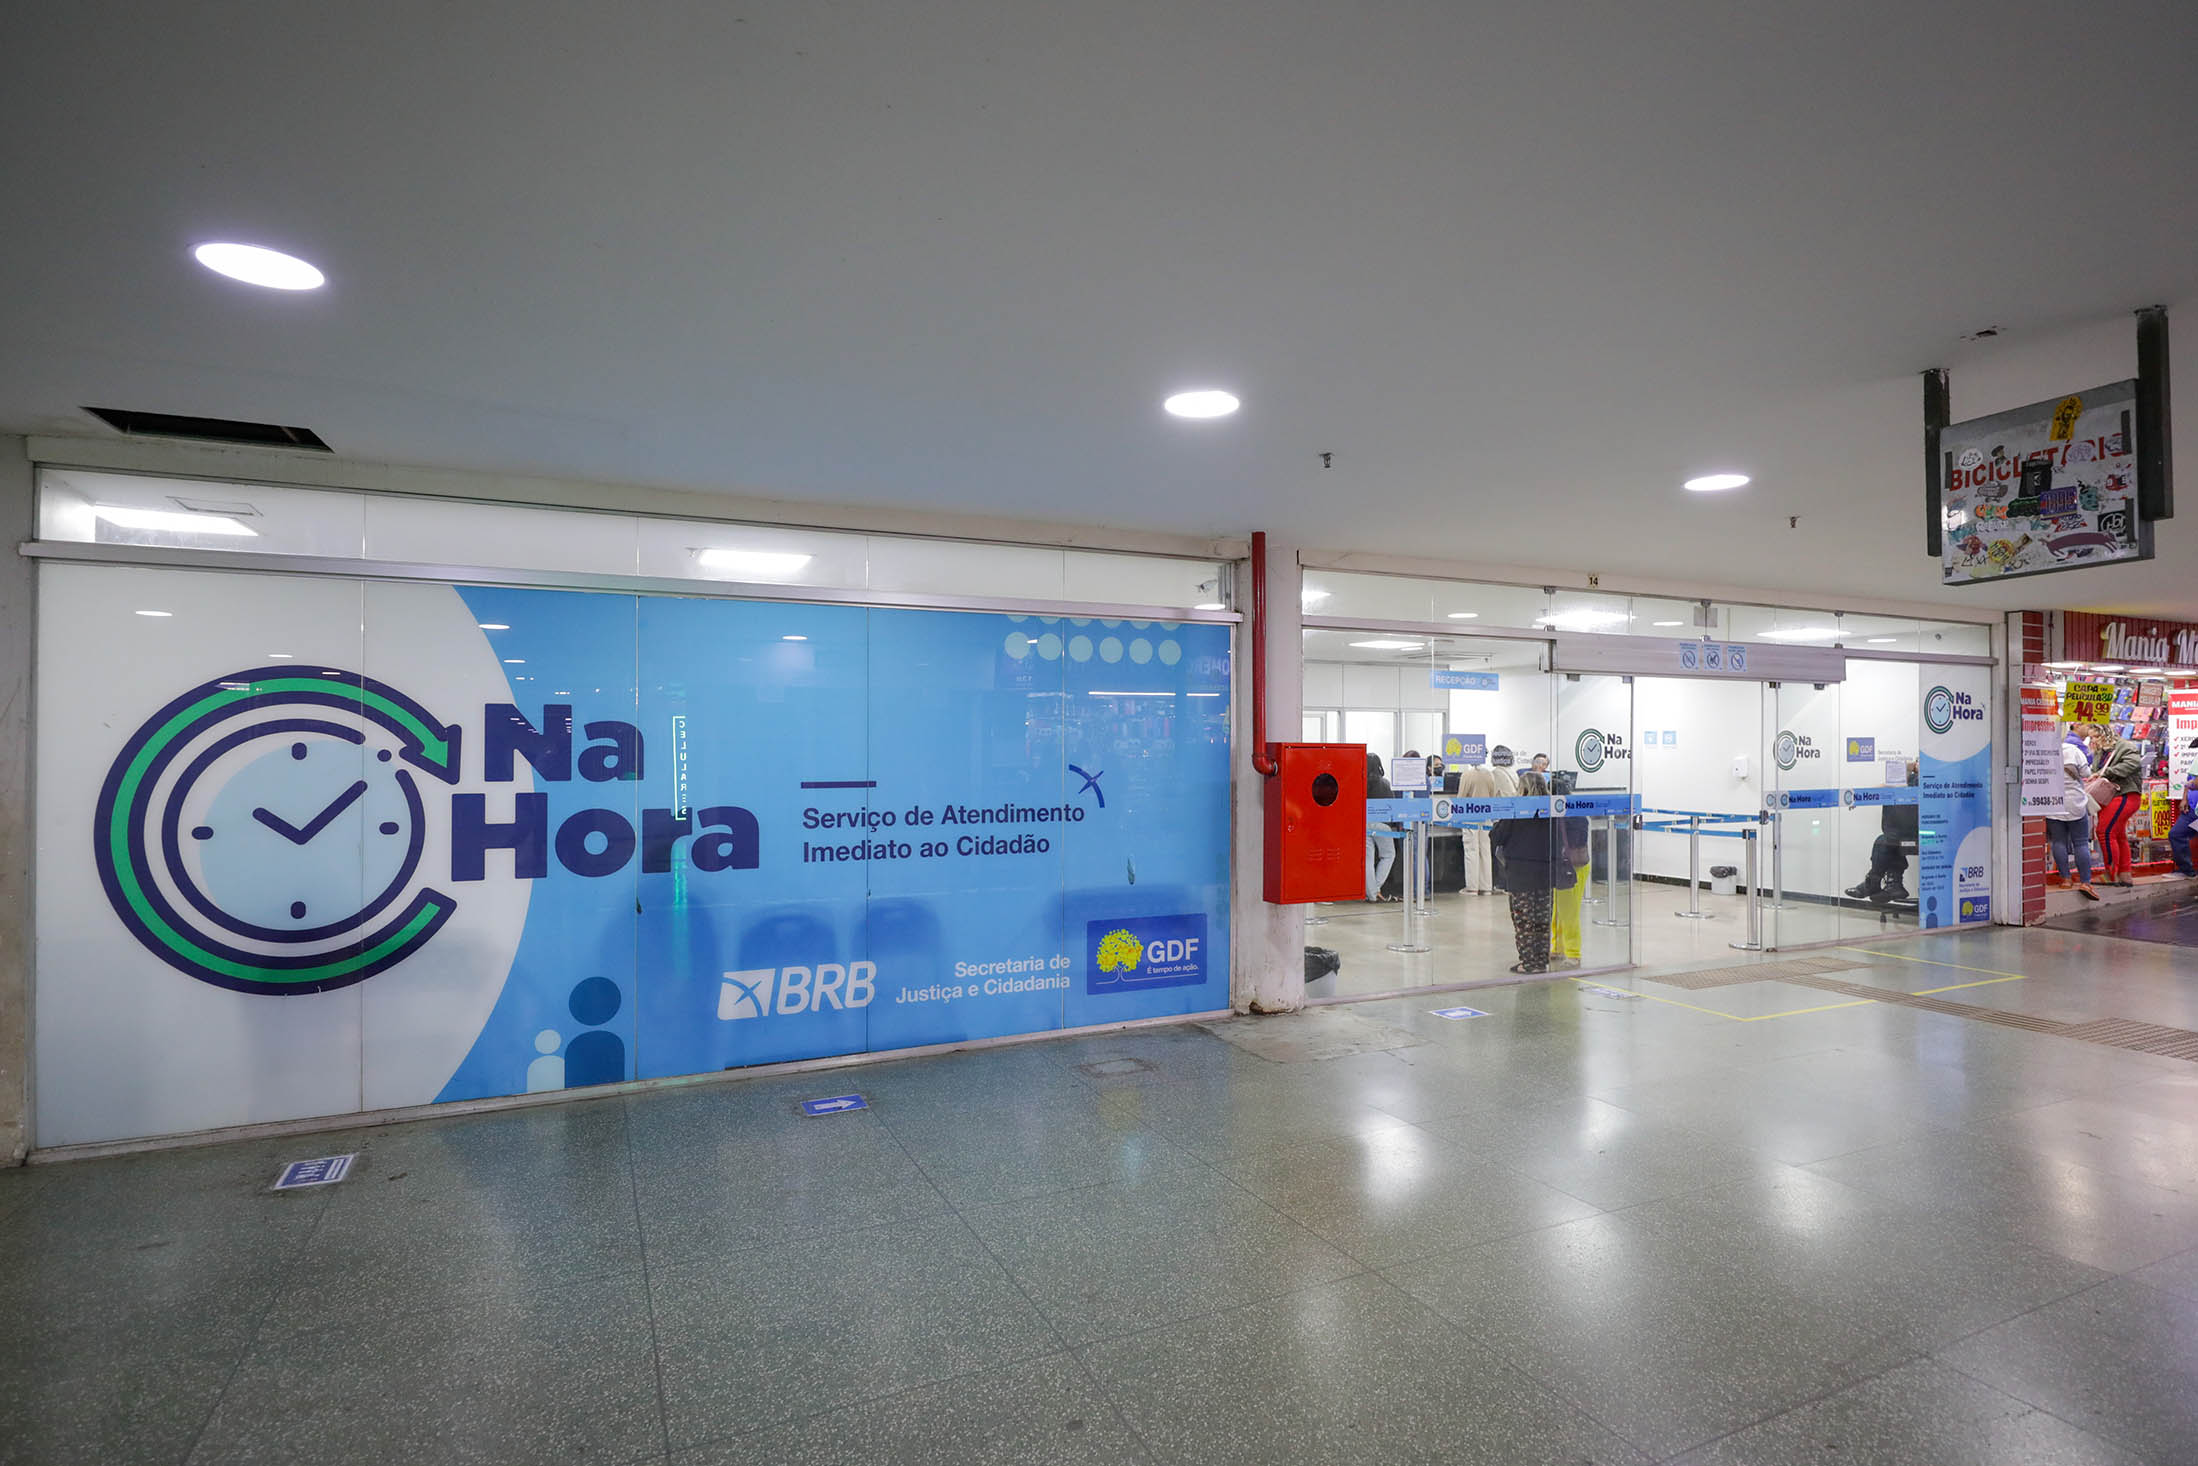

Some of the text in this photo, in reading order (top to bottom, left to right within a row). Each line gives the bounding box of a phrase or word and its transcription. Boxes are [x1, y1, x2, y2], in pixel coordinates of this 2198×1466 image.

[1589, 576, 1599, 585] 14
[2102, 622, 2169, 662] Mania
[2073, 684, 2098, 692] CAPA
[1955, 692, 1972, 705] Na
[1952, 705, 1984, 720] Hora
[484, 703, 645, 783] Na
[1607, 733, 1622, 745] Na
[1799, 735, 1811, 746] Na
[1463, 743, 1484, 754] GDF
[1796, 747, 1821, 759] Hora
[1853, 792, 1880, 801] Na Hora
[1451, 804, 1464, 814] Na
[1466, 803, 1492, 814] Hora
[1576, 800, 1594, 809] Hora
[802, 803, 1085, 833] Serviço de Atendimento
[451, 792, 760, 879] Hora
[803, 834, 1051, 863] Imediato ao Cidadão
[1967, 866, 1984, 879] BRB
[1974, 904, 1988, 913] GDF
[1147, 938, 1200, 963] GDF
[954, 954, 1071, 978] Secretaria de
[1147, 966, 1152, 974] É
[1173, 964, 1182, 972] de
[776, 960, 877, 1015] BRB
[895, 975, 1071, 1004] Justiça e Cidadania
